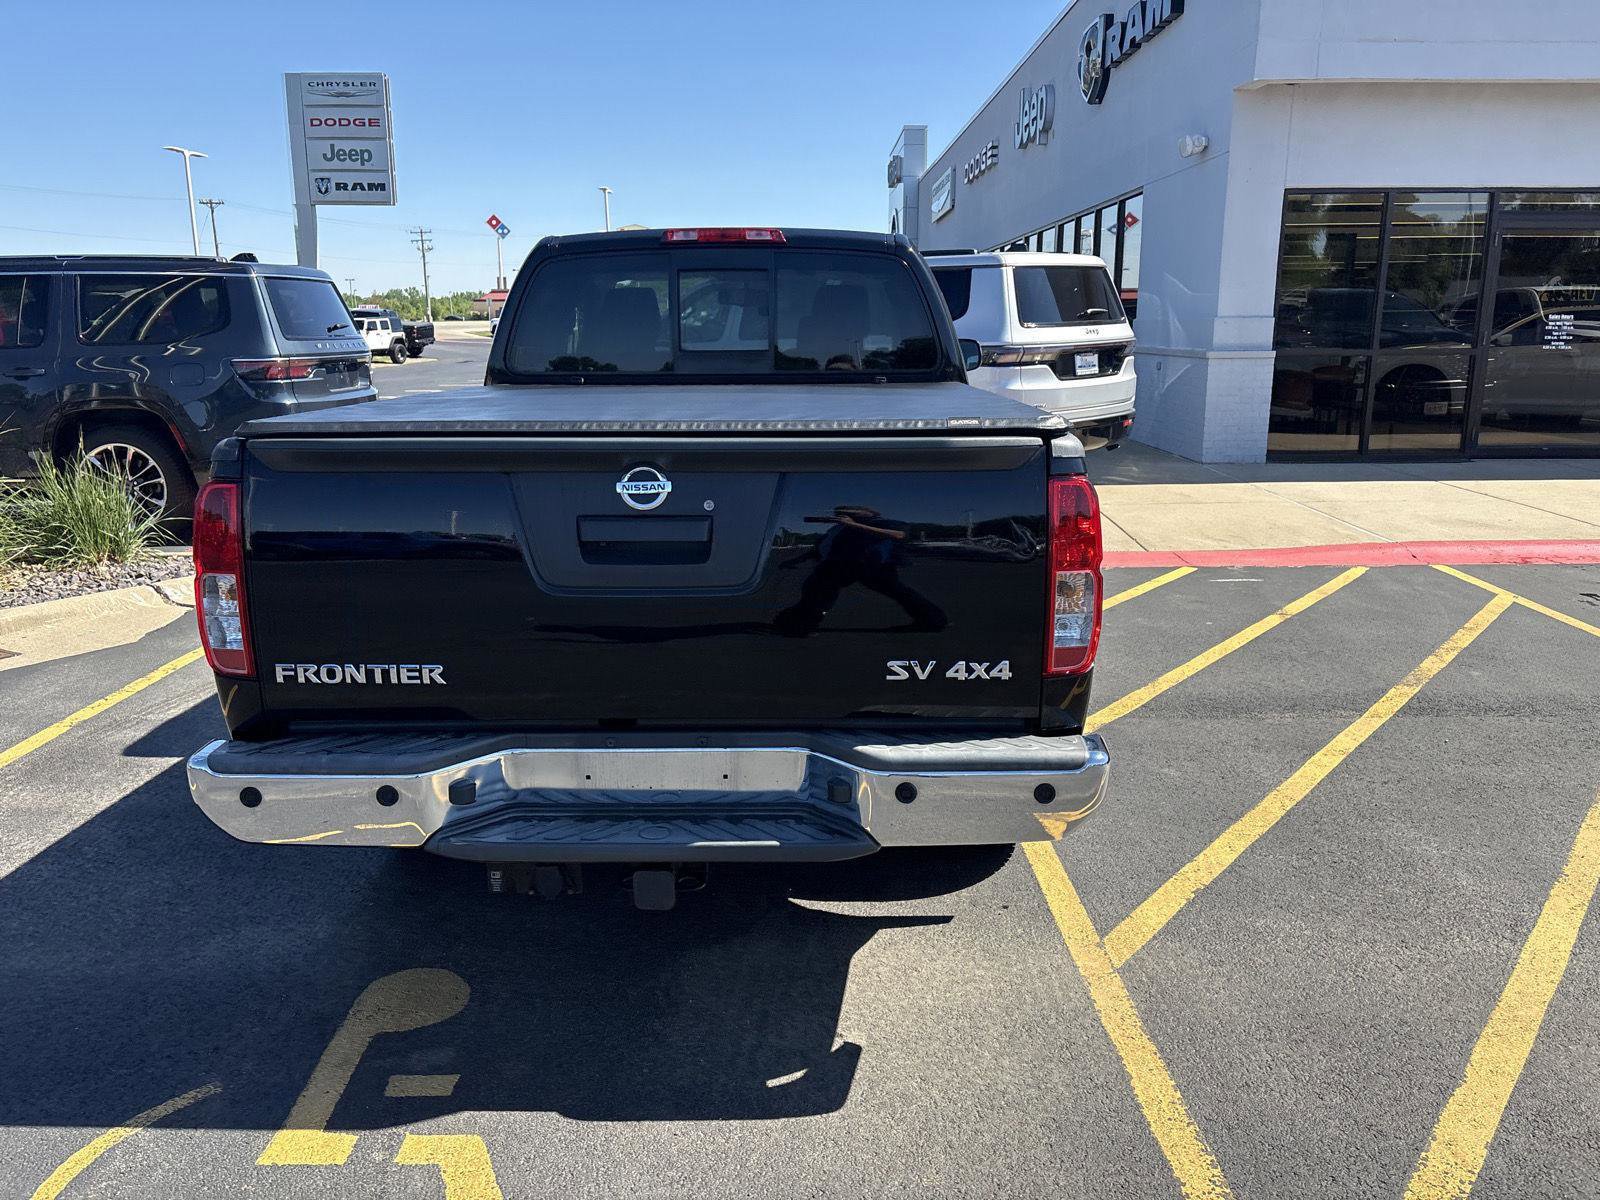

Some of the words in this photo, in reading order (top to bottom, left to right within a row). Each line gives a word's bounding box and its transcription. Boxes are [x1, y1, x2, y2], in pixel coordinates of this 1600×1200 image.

[1104, 0, 1180, 68] RAM
[310, 118, 381, 127] DODGE
[1014, 84, 1053, 150] Jeep
[322, 143, 373, 166] Jeep
[964, 141, 998, 184] DODGE
[335, 182, 386, 192] RAM
[621, 483, 666, 492] NISSAN
[275, 663, 447, 685] FRONTIER
[886, 660, 936, 680] SV
